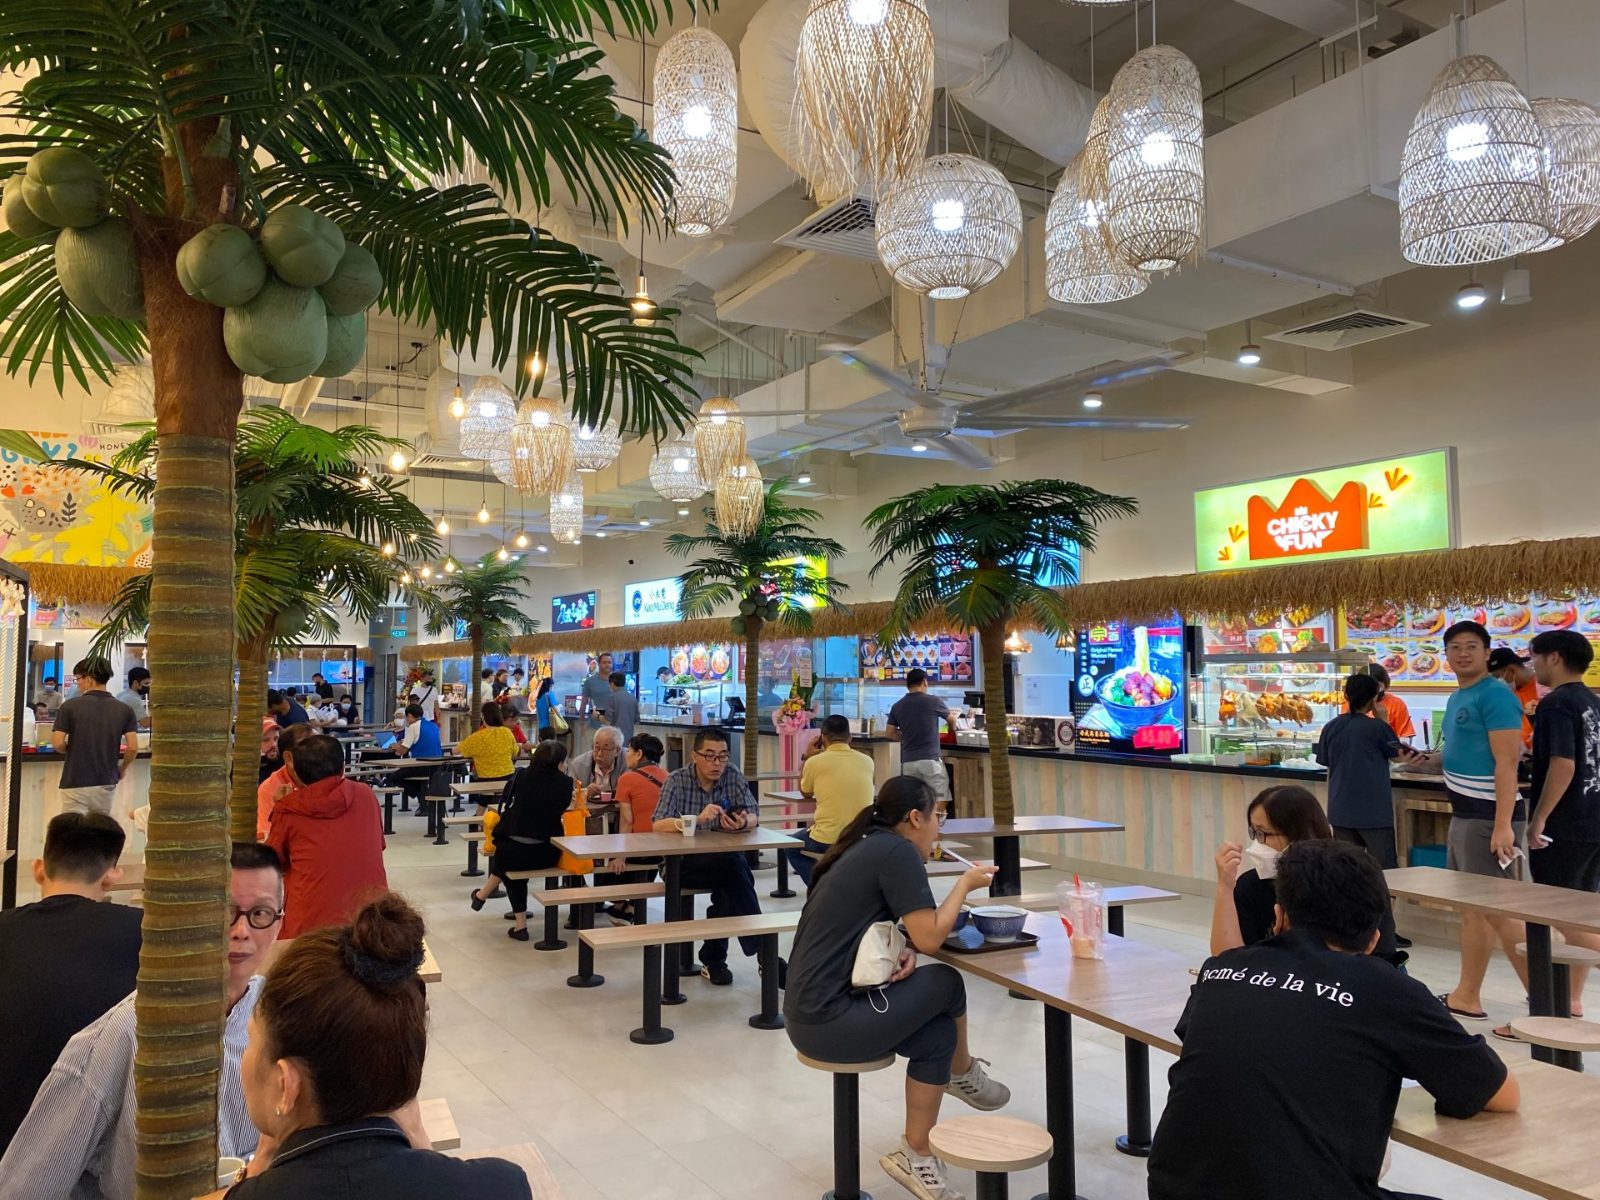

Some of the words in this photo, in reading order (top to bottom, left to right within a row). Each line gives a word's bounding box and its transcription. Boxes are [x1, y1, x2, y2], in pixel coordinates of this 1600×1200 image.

[1267, 510, 1339, 536] CHICKY
[1274, 530, 1333, 552] FUN
[1203, 967, 1248, 982] acmé
[1249, 972, 1277, 987] de
[1279, 973, 1305, 992] la
[1314, 982, 1354, 1007] vie
